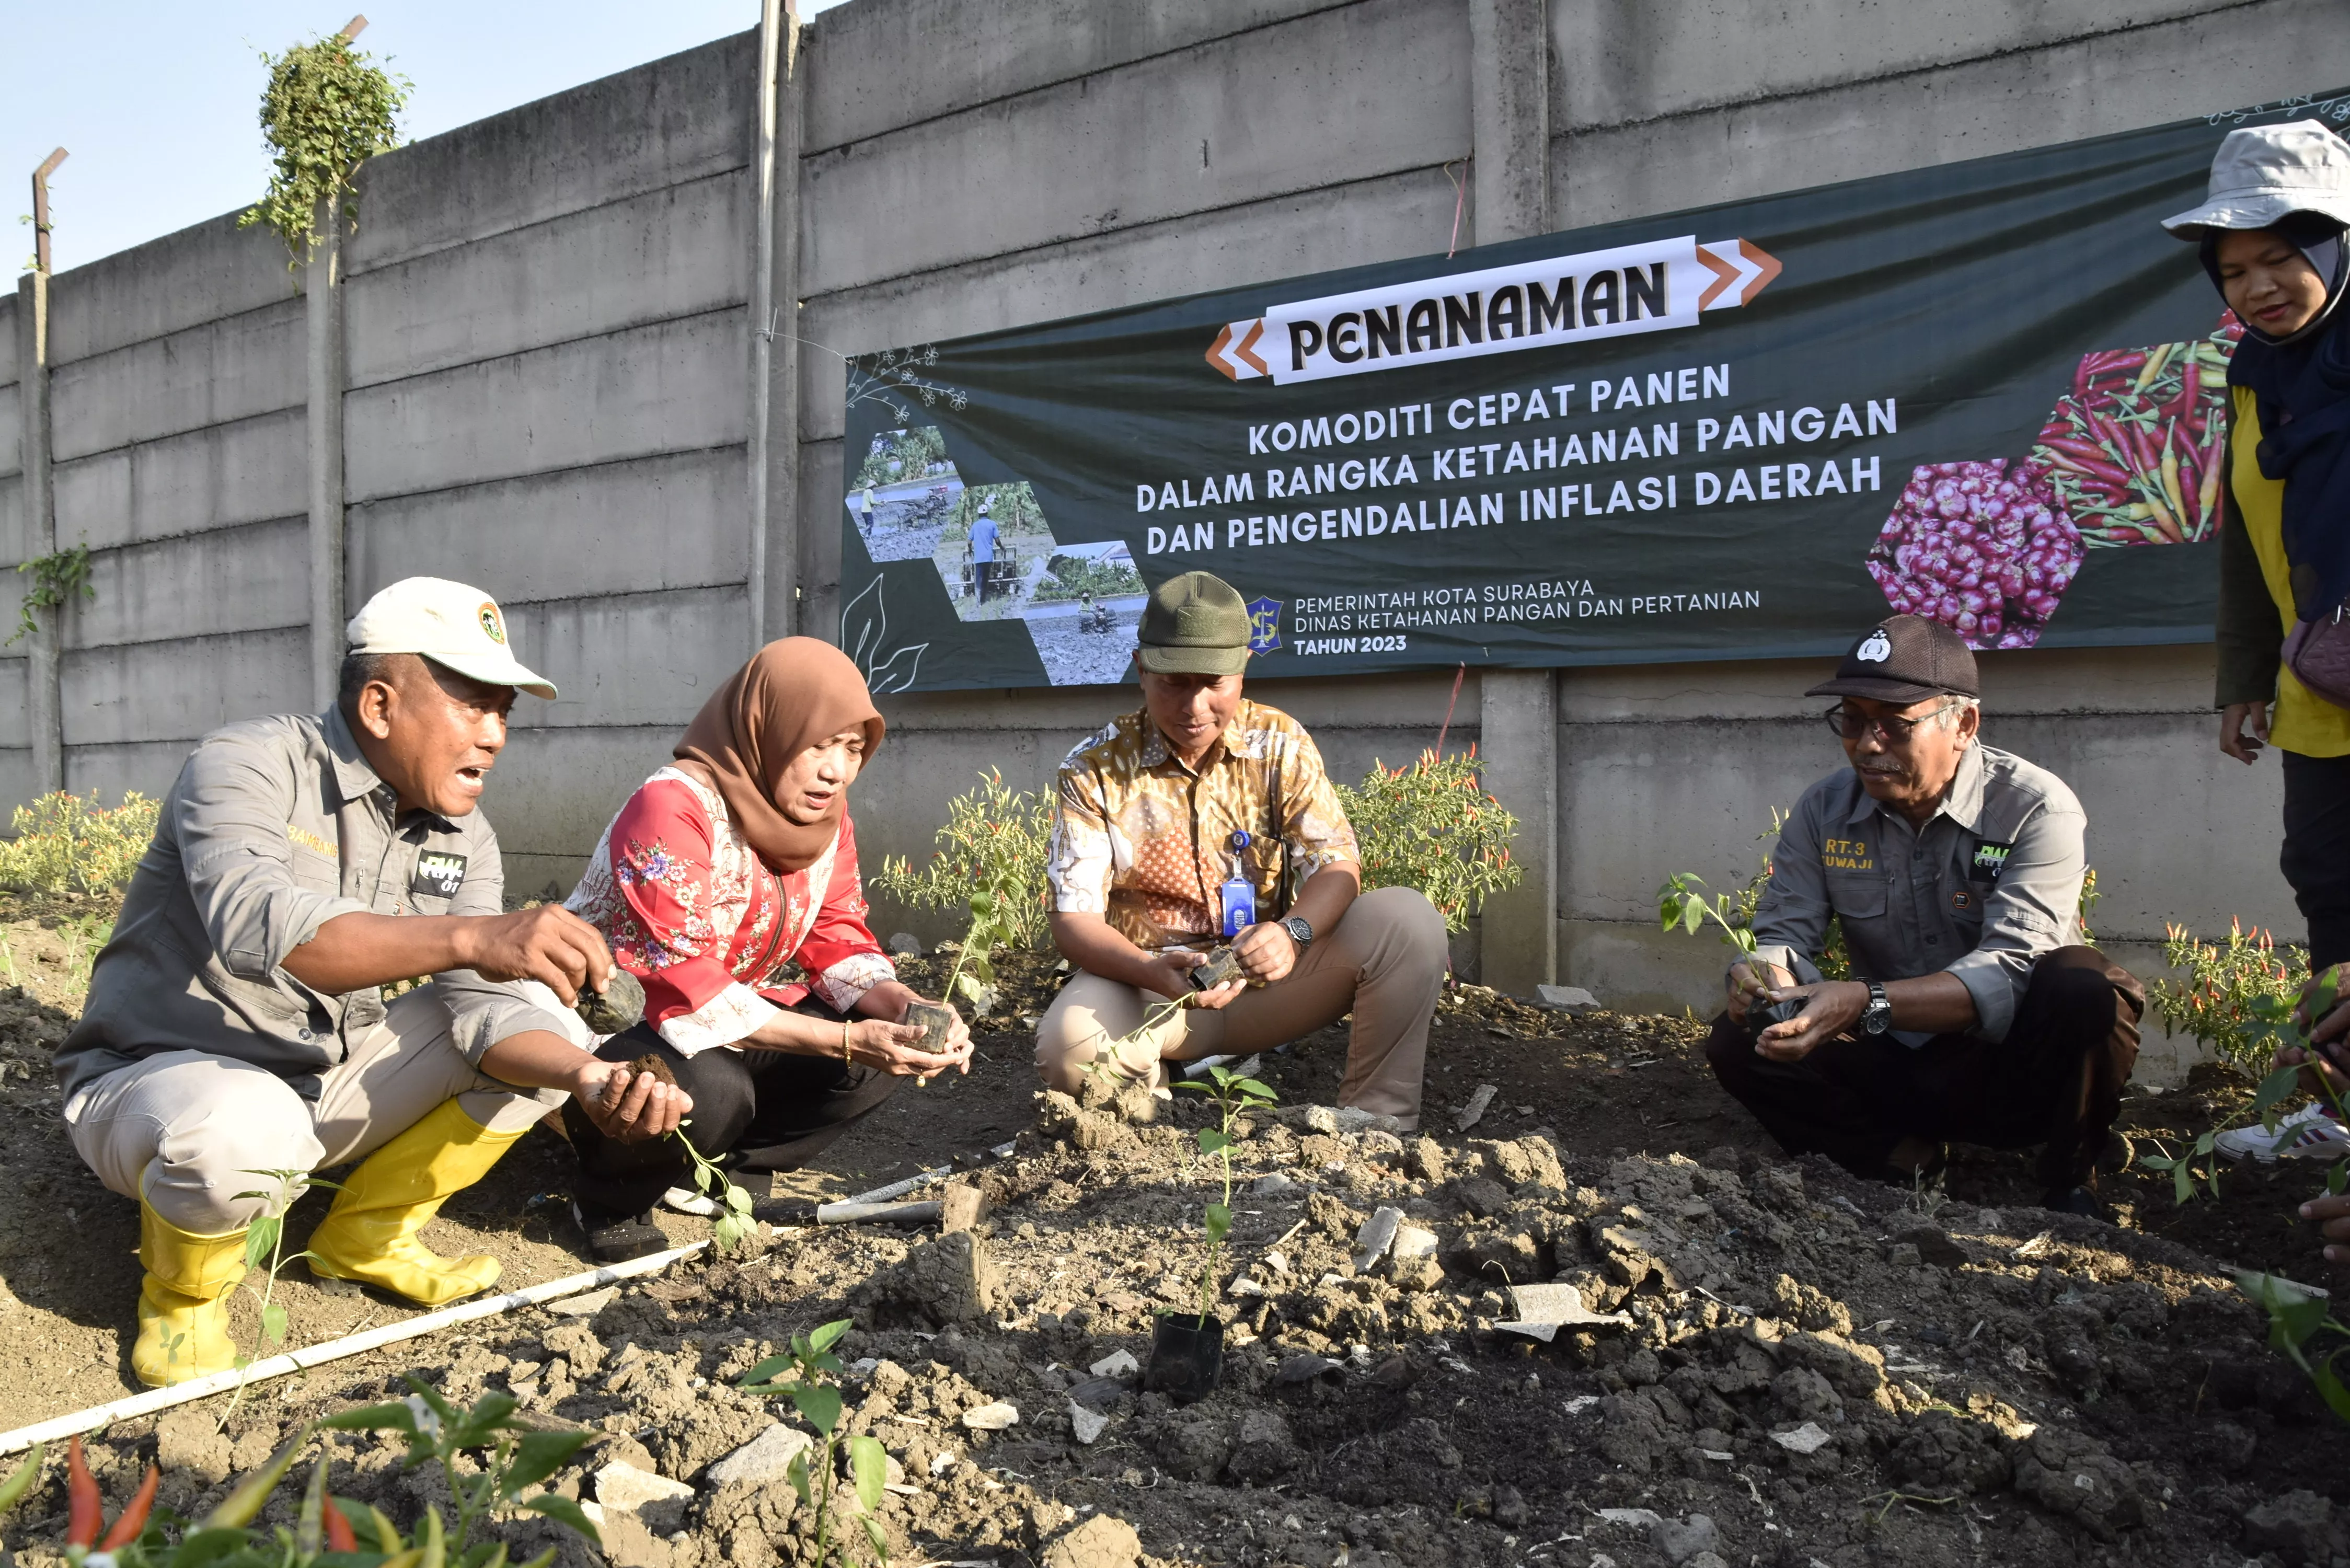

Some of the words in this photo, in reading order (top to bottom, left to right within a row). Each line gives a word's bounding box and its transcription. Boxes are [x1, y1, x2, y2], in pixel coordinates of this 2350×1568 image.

[1286, 261, 1671, 371] PENANAMAN
[1249, 403, 1433, 455] KOMODITI
[1447, 384, 1575, 430] CEPAT
[1591, 363, 1730, 412] PANEN
[1137, 472, 1254, 513] DALAM
[1267, 454, 1419, 499] RANGKA
[1433, 422, 1678, 481] KETAHANAN
[1697, 398, 1897, 452] PANGAN
[1147, 522, 1214, 555] DAN
[1228, 492, 1503, 548] PENGENDALIAN
[1520, 475, 1676, 522] INFLASI
[1695, 456, 1880, 505] DAERAH
[1295, 615, 1351, 633] DINAS
[1358, 607, 1476, 629] KETAHANAN
[1484, 602, 1570, 622] PANGAN
[1579, 598, 1622, 617] DAN
[1632, 590, 1759, 614] PERTANIAN
[1296, 591, 1416, 614] PEMERINTAH
[1423, 587, 1477, 606] KOTA
[1483, 580, 1594, 602] SURABAYA
[1294, 637, 1356, 655] TAHUN
[1360, 635, 1407, 652] 2023
